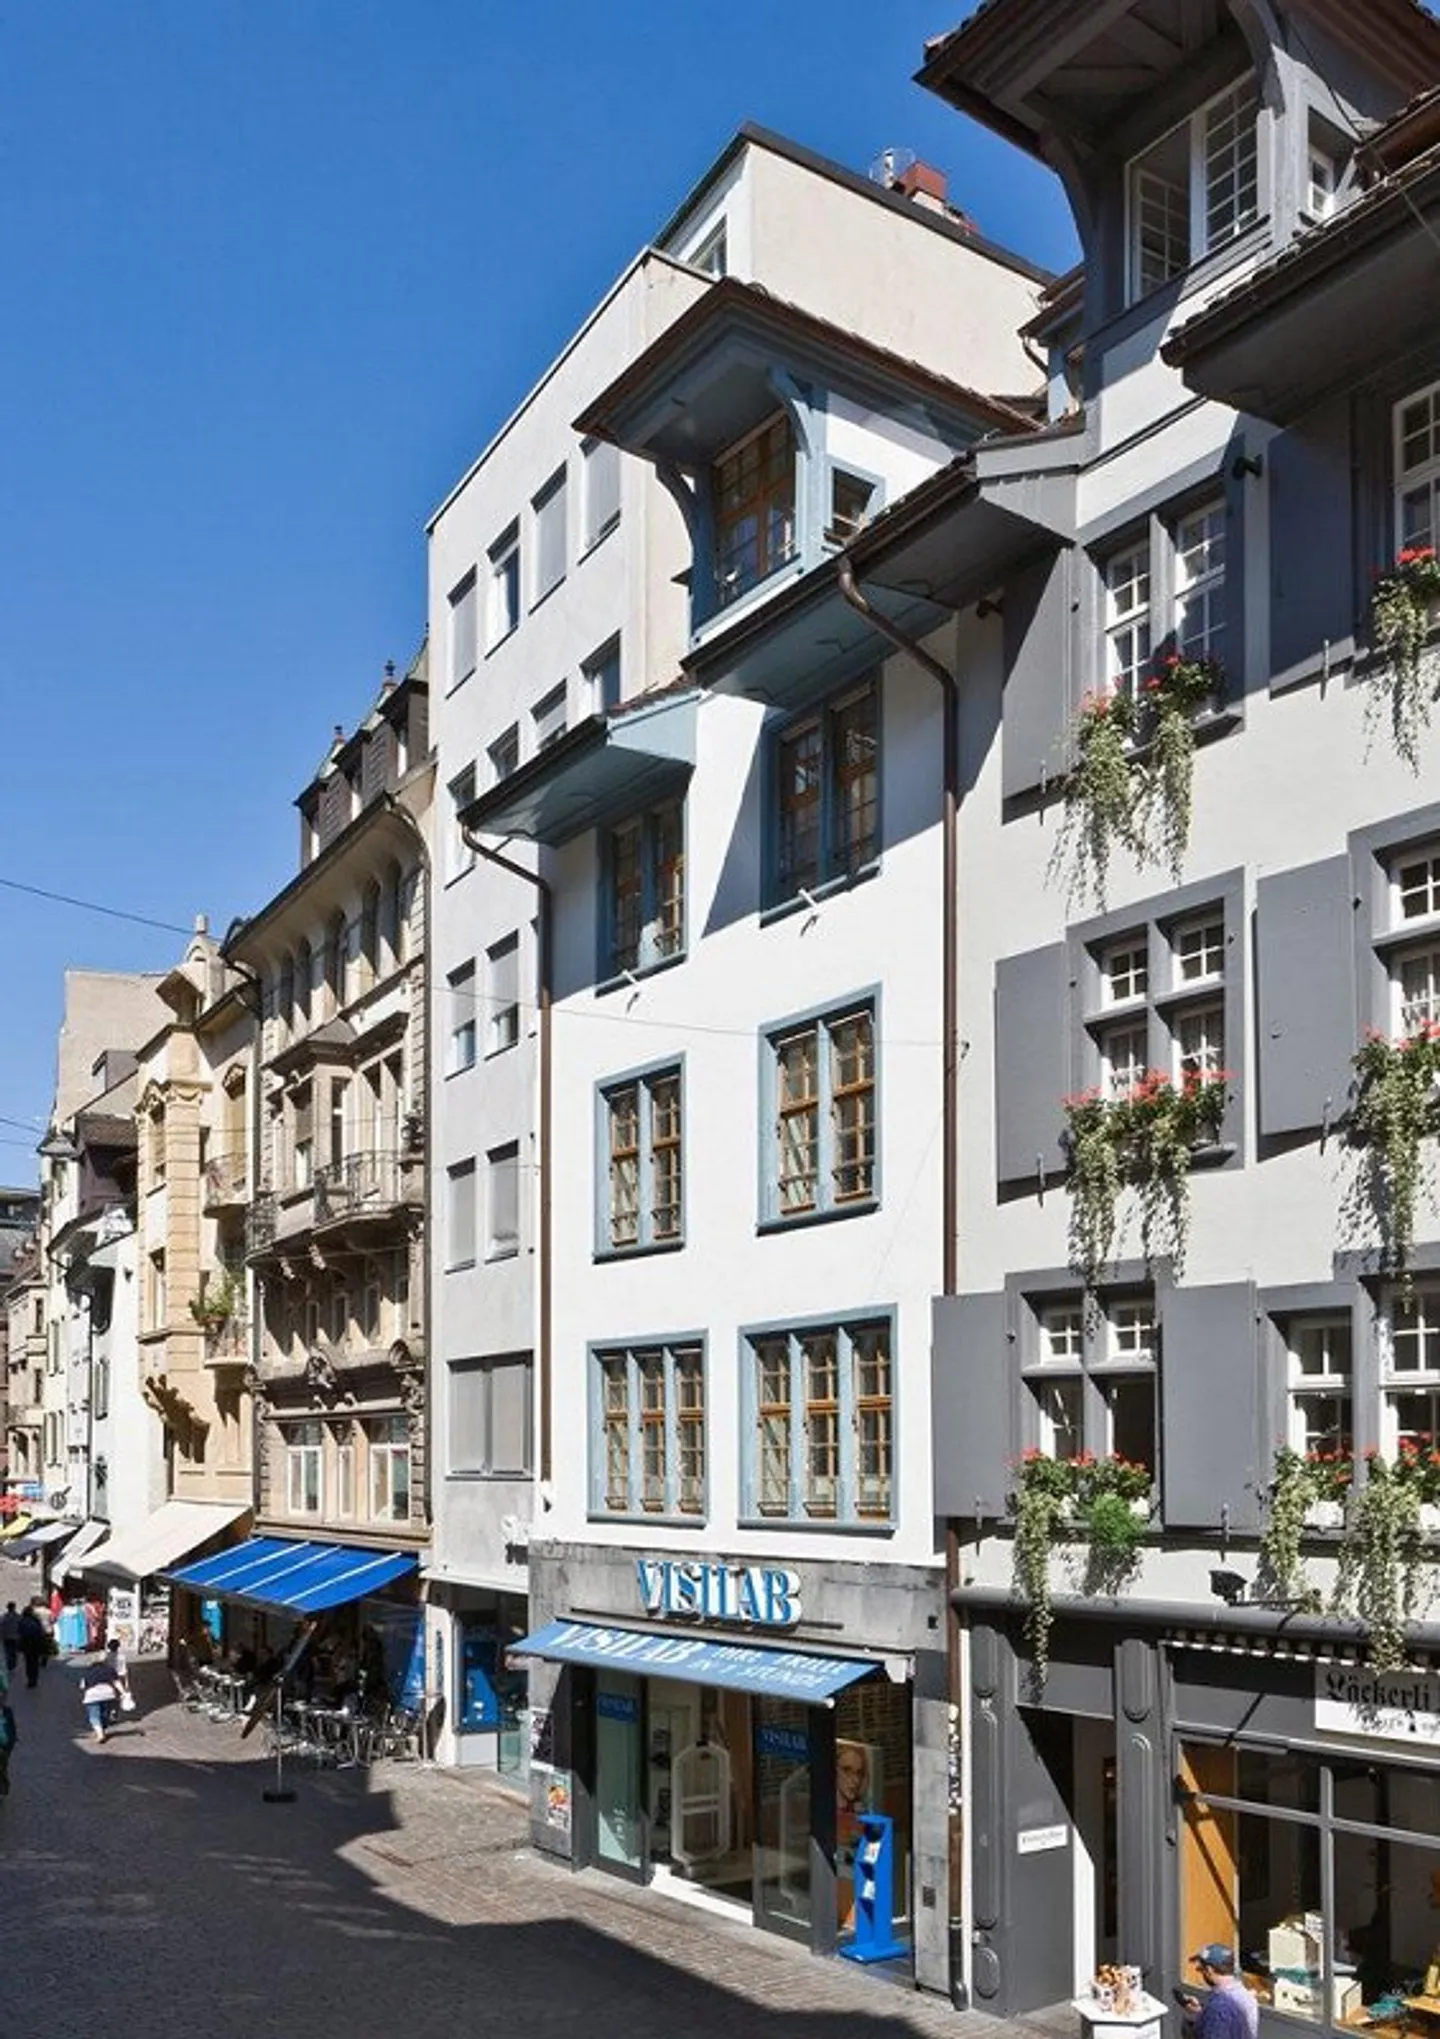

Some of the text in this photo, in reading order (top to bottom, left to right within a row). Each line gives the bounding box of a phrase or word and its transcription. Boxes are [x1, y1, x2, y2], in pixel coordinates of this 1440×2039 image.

[636, 1560, 801, 1626] VISILAB
[547, 1624, 707, 1663] VISILAB
[1326, 1671, 1430, 1711] Läckerli
